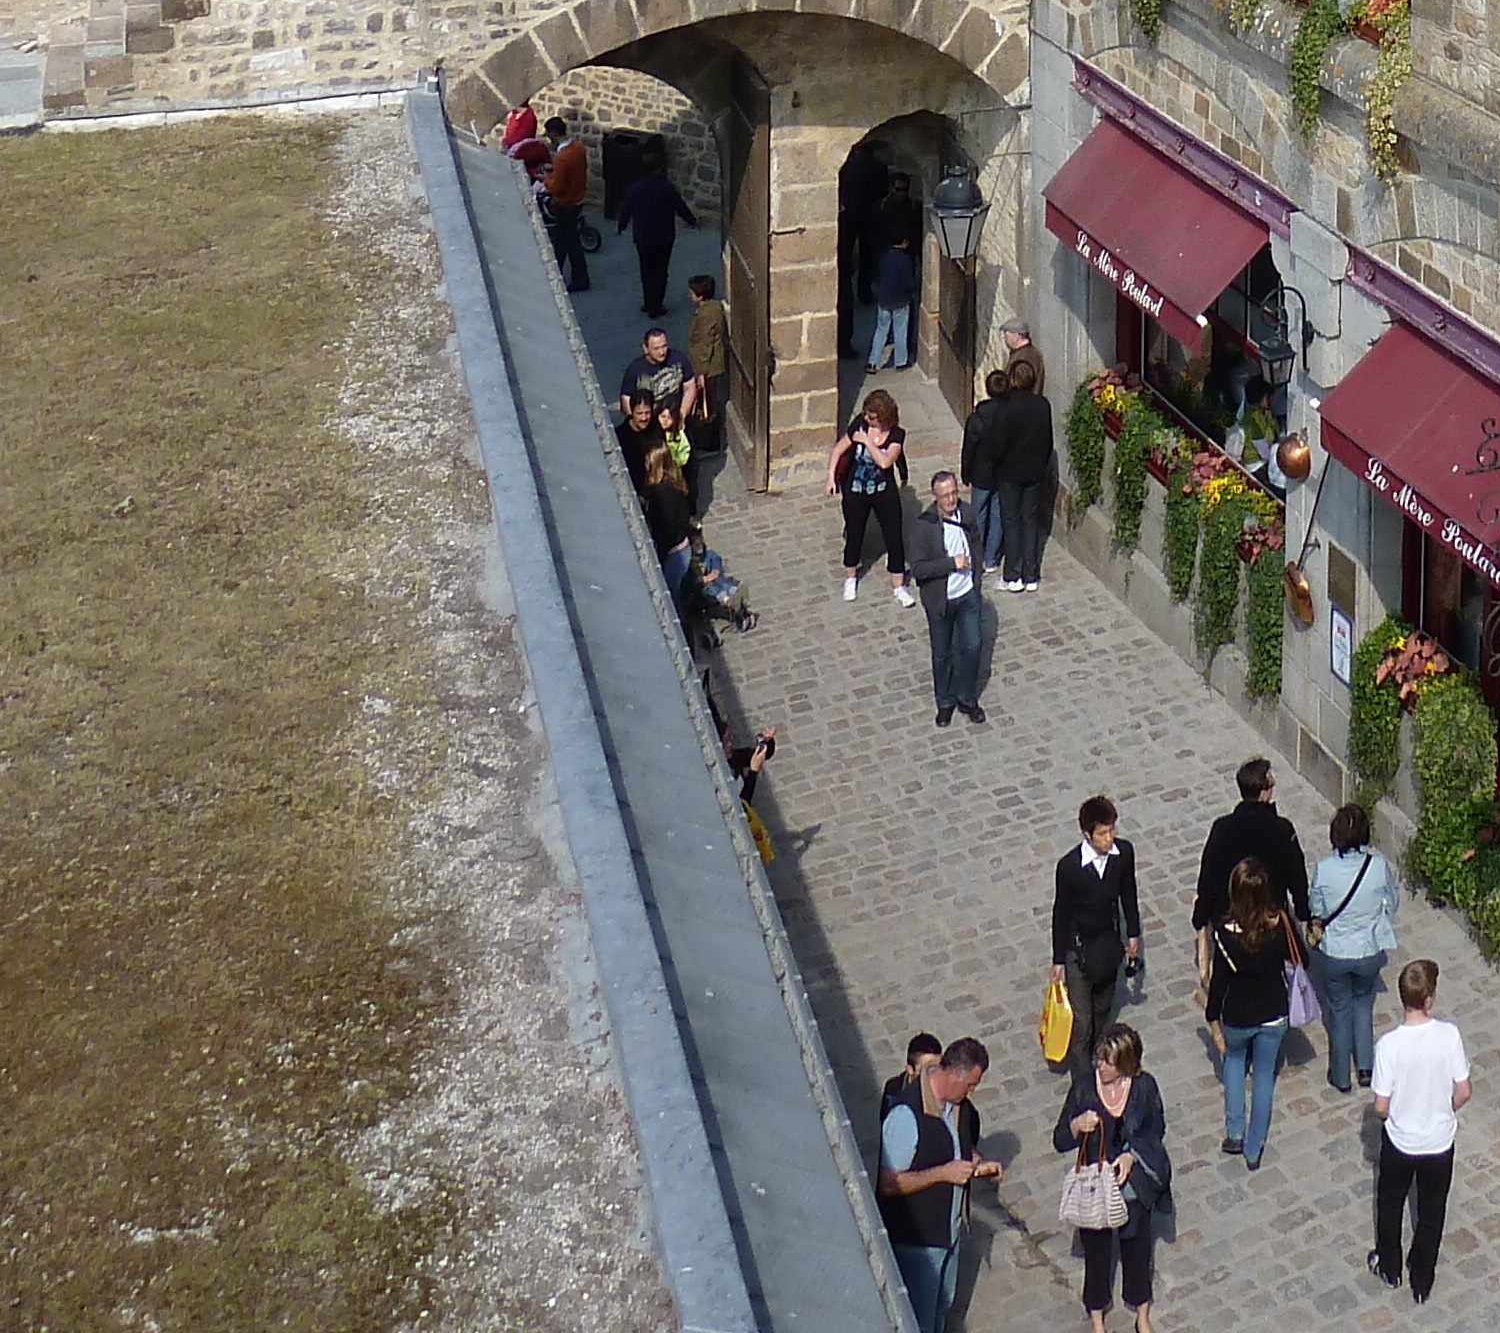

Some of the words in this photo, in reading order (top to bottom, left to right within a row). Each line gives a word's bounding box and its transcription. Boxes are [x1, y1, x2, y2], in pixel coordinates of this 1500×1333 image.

[1076, 231, 1091, 258] La
[1364, 457, 1389, 491] La
[1393, 483, 1435, 526] Mère
